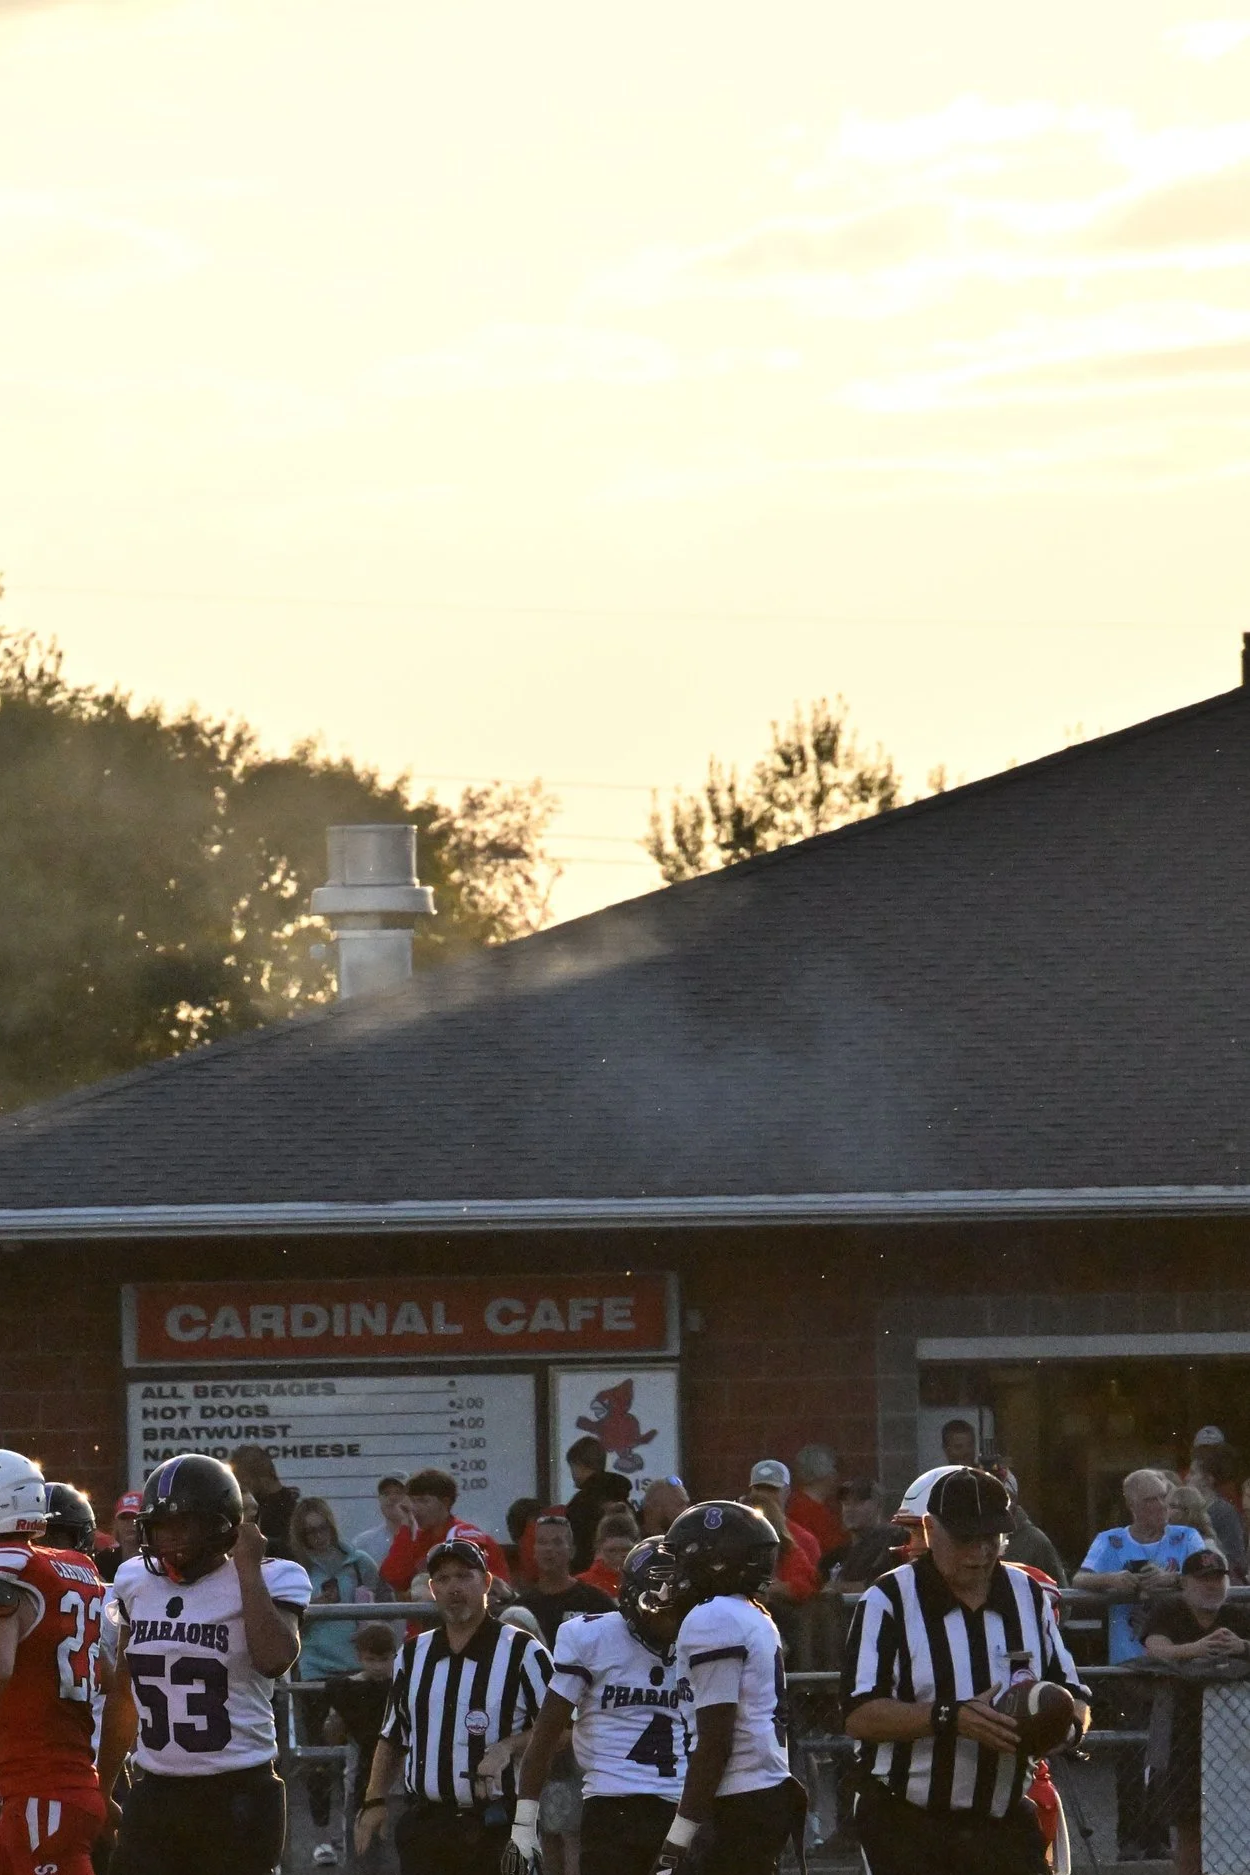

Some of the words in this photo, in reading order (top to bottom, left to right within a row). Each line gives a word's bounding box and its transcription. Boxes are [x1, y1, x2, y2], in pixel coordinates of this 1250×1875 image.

[164, 1301, 463, 1343] CARDINAL
[484, 1297, 636, 1336] CAFE
[142, 1385, 184, 1400] ALL
[193, 1382, 337, 1399] BEVERAGES
[141, 1406, 191, 1421] HOT
[200, 1404, 270, 1420] DOGS
[142, 1424, 292, 1442] BRATWURST
[704, 1506, 723, 1530] 8
[126, 1652, 232, 1753] 53
[626, 1713, 679, 1778] 4
